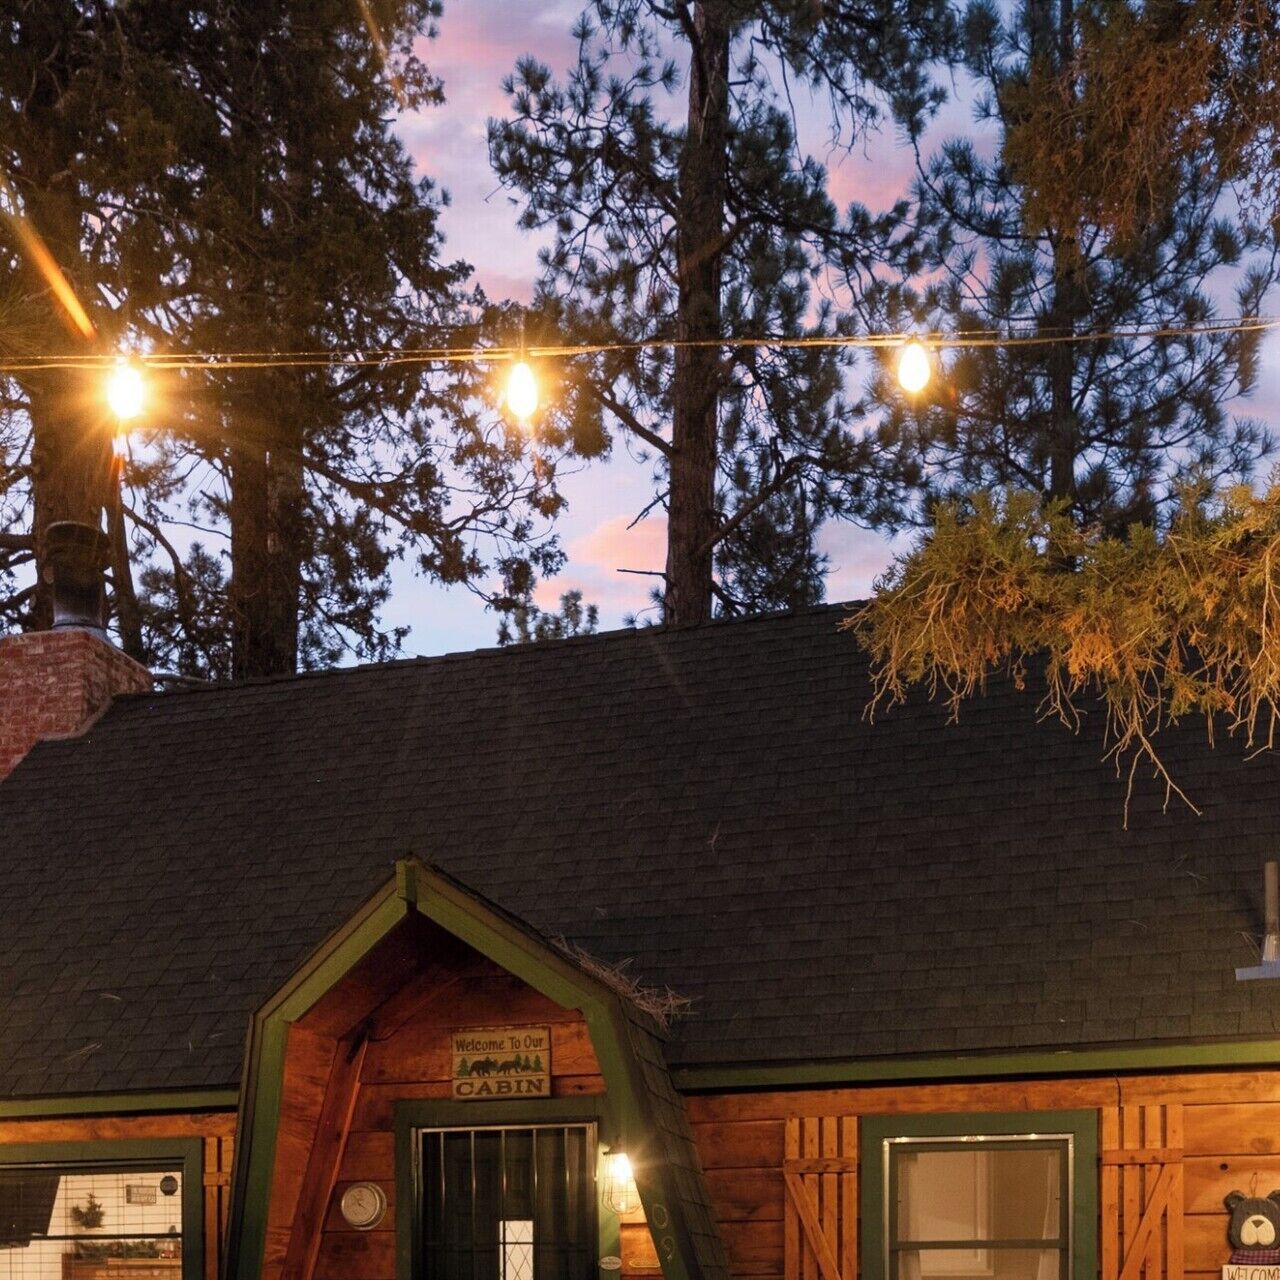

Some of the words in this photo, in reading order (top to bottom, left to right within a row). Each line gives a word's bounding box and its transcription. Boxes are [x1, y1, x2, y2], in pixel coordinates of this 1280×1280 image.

[456, 1038, 504, 1052] Welcome
[508, 1036, 520, 1050] To
[524, 1034, 545, 1050] Our
[455, 1078, 544, 1096] CABIN
